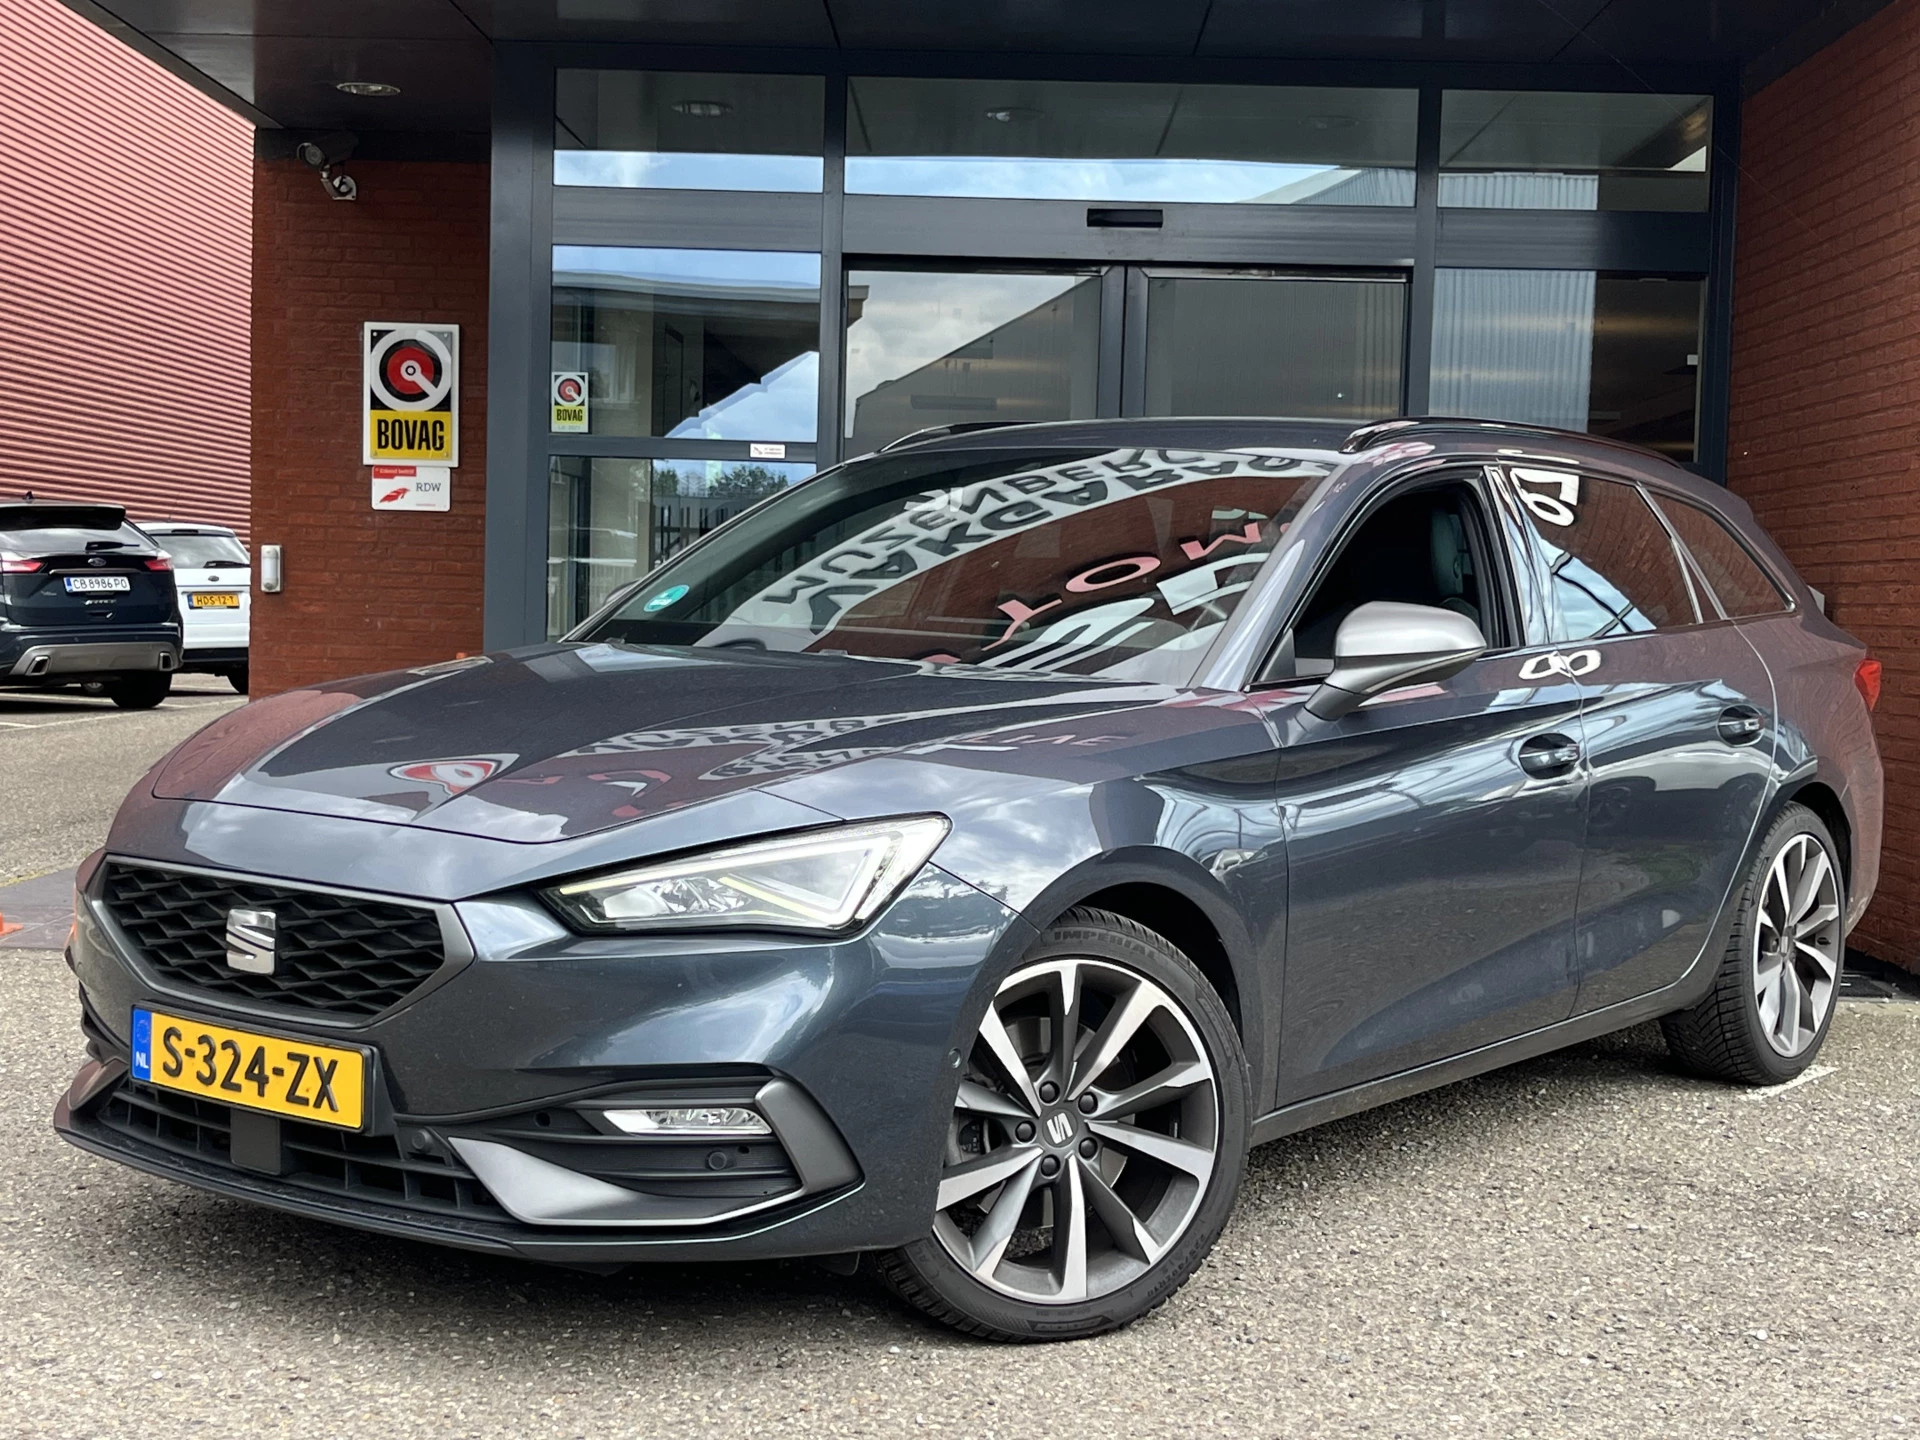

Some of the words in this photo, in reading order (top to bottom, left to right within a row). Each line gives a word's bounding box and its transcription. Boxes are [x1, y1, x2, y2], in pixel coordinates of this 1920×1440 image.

[556, 409, 584, 422] BOVAG
[377, 420, 445, 451] BOVAG
[416, 482, 442, 492] RDW
[196, 594, 235, 605] HDS-12-T
[135, 1051, 150, 1070] NL
[162, 1026, 339, 1113] S-324-ZX
